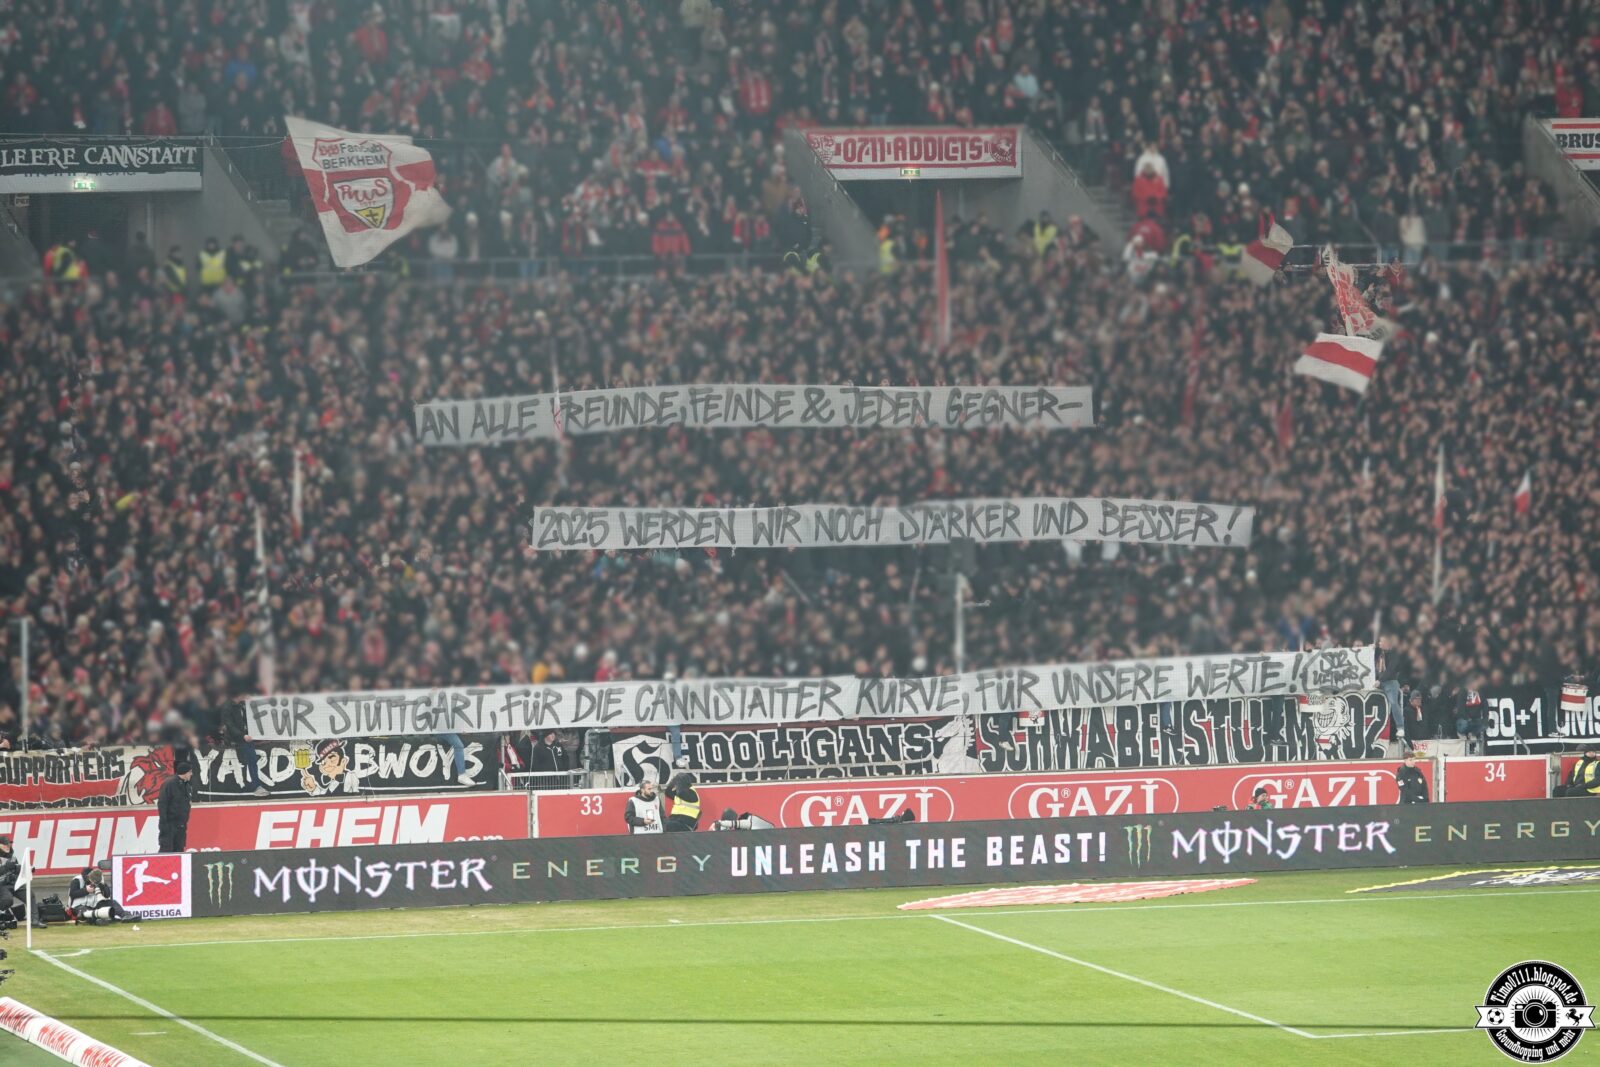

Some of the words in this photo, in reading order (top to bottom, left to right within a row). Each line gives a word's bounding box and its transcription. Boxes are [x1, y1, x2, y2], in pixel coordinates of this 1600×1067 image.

[0, 147, 80, 169] LEERE
[84, 145, 197, 168] CANNSTATT
[322, 155, 386, 169] BERKHEIM
[842, 137, 885, 162] 0711
[417, 406, 460, 441] AN
[470, 399, 540, 437] ALLE
[688, 387, 795, 423] FEINDE
[800, 387, 834, 424] &
[840, 387, 931, 424] JEDEN
[538, 508, 610, 547] 2025
[619, 509, 735, 546] WERDEN
[752, 506, 802, 546] WIR
[815, 507, 884, 543] NOCH
[899, 501, 1023, 541] STÄRKER
[1033, 501, 1089, 537] UND
[1099, 500, 1243, 546] BESSER!
[250, 696, 316, 737] FÜR
[326, 688, 497, 736] STUTTGART,
[500, 689, 562, 728] FÜR
[570, 687, 626, 723] DIE
[635, 679, 844, 721] CANNSTATTER
[855, 675, 970, 714] KURVE,
[975, 669, 1042, 712] FÜR
[1052, 664, 1172, 706] UNSERE
[1186, 652, 1303, 697] WERTE!
[1486, 697, 1543, 737] 50+1
[194, 748, 295, 788] YARD
[354, 742, 484, 784] BWOYS
[667, 722, 935, 771] HOOLIGANS
[1484, 763, 1506, 782] 34
[255, 804, 449, 850] EHEIM
[580, 795, 603, 816] 33
[253, 855, 493, 902] MONSTER
[513, 854, 711, 880] ENERGY
[731, 840, 886, 877] UNLEASH
[906, 837, 966, 869] THE
[987, 832, 1106, 867] BEAST!
[1171, 819, 1396, 863] MONSTER
[1415, 820, 1600, 842] ENERGY
[126, 909, 182, 918] UNDESLIGA
